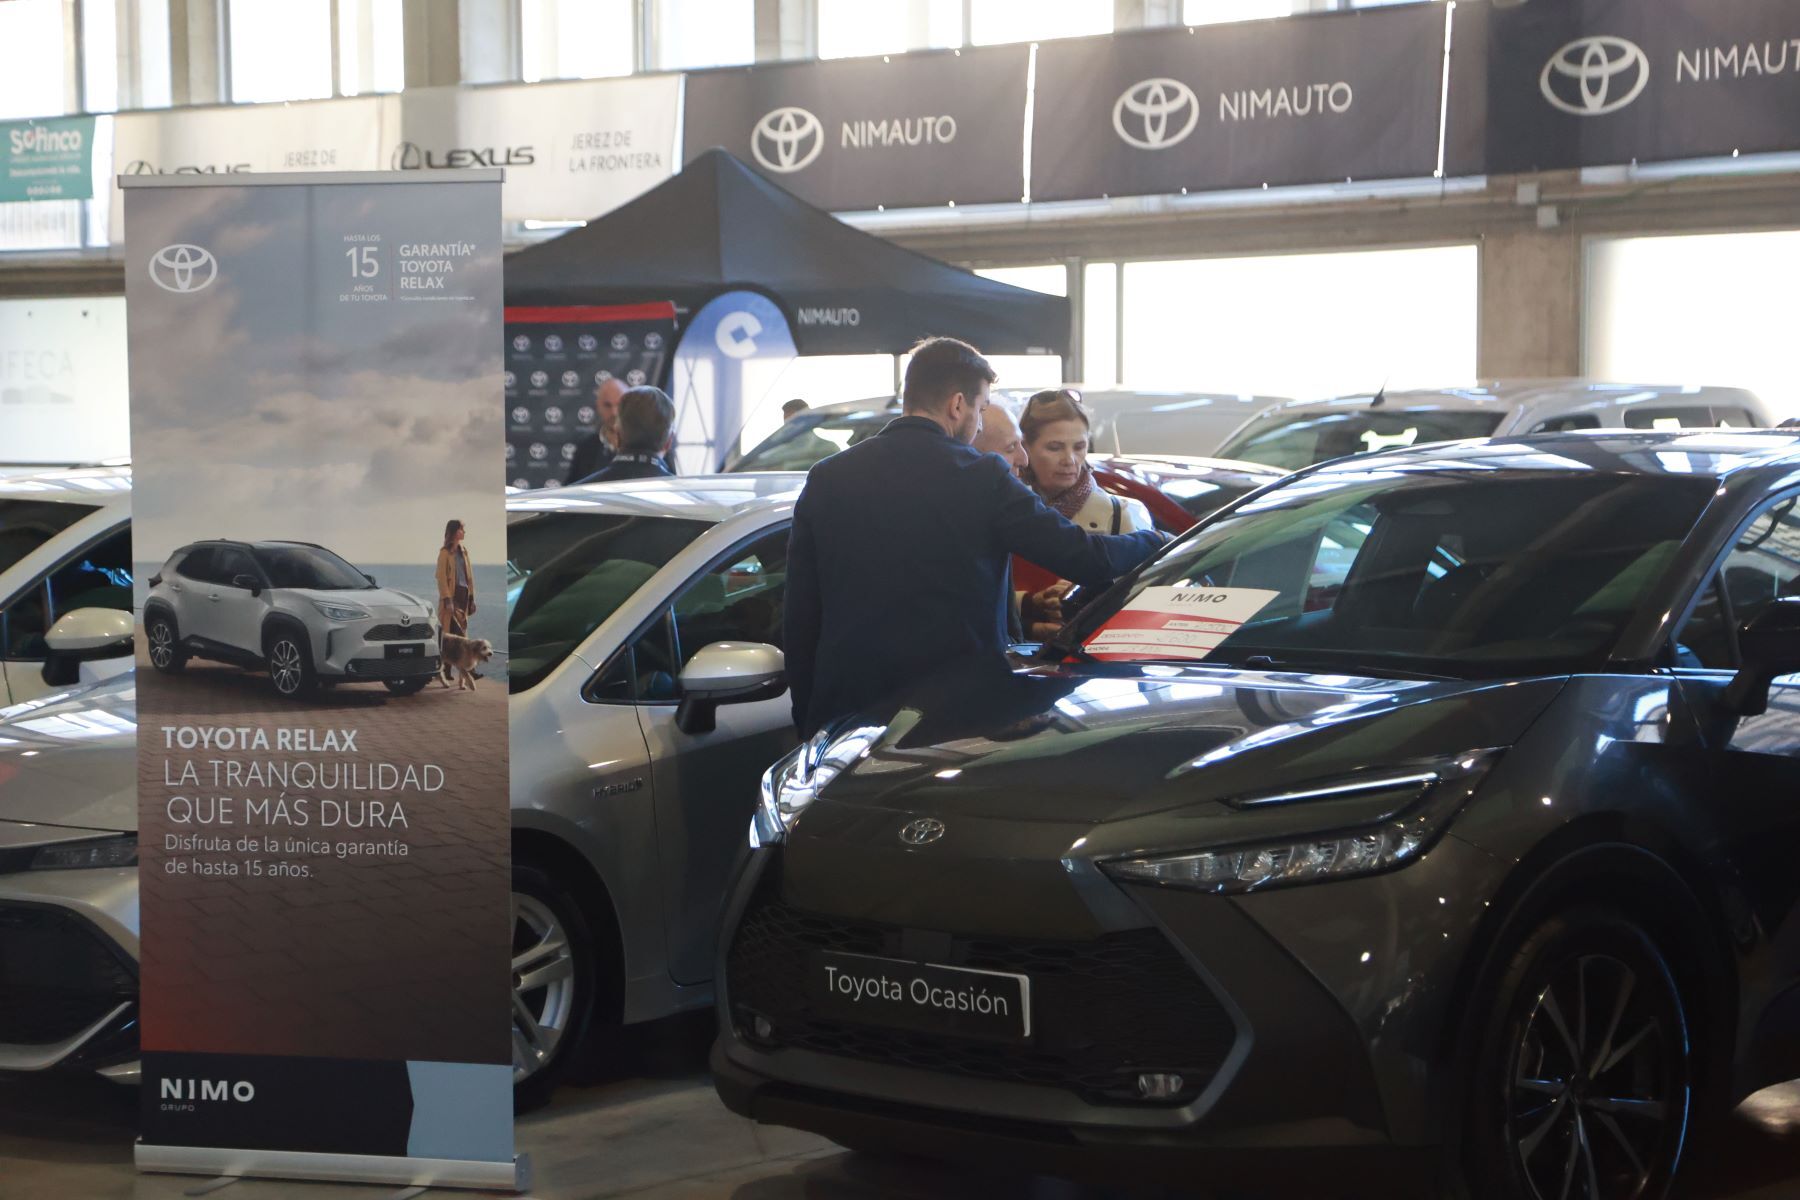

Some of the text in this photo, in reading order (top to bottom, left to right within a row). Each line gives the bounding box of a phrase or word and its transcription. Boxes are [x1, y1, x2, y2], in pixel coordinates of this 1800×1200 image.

[1219, 81, 1353, 121] NIMAUTO
[10, 126, 82, 154] Sofinco
[571, 130, 632, 150] JEREZ DE
[841, 115, 957, 149] NIMAUTO
[283, 149, 337, 167] JEREZ DE
[425, 146, 535, 169] LEXUS
[568, 153, 662, 173] LA FRONTERA
[343, 234, 381, 242] HASTA LOS
[345, 246, 379, 278] 15
[400, 260, 454, 273] TOYOTA
[353, 284, 374, 293] AÑOS
[400, 276, 445, 289] RELAX
[361, 293, 388, 301] TOYOTA
[797, 308, 861, 326] NIMAUTO
[1170, 593, 1228, 604] NIMO
[161, 726, 358, 752] TOYOTA RELAX
[164, 759, 445, 792] LA TRANQUILIDAD
[167, 792, 409, 829] QUE MÁS DURA
[165, 834, 409, 858] Disfruta de la única garantía
[165, 858, 314, 878] de hasta 15 años.
[824, 966, 1008, 1016] Toyota Ocasión
[160, 1078, 255, 1103] NIMO
[160, 1104, 196, 1112] GRUPO
